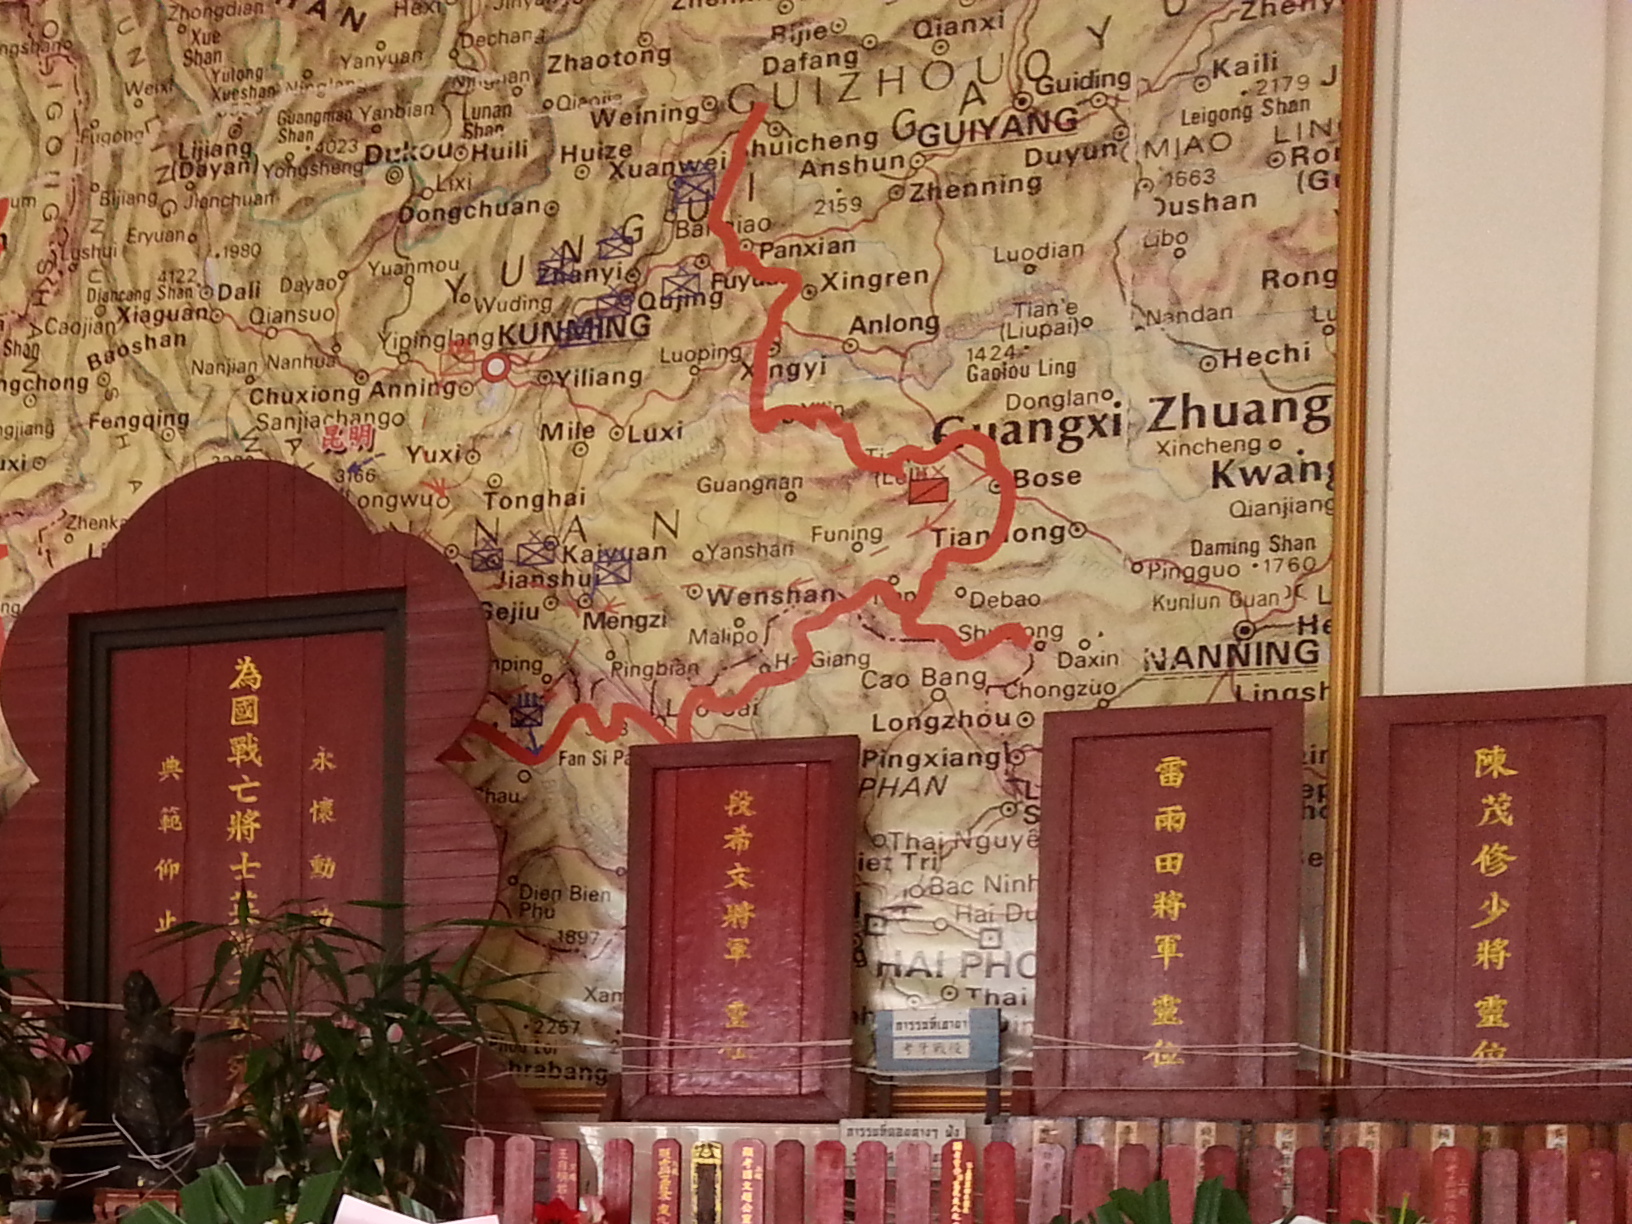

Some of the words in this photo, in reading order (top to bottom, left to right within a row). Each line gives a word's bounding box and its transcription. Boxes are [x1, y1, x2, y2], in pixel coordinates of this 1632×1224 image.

[168, 3, 265, 22] Zhongdian
[913, 11, 1005, 40] Qianxi
[191, 29, 220, 45] Xue
[183, 50, 222, 68] Shan
[548, 48, 672, 75] Zhaotong
[763, 50, 860, 76] Dafang
[1212, 50, 1279, 79] Kaili
[1035, 72, 1132, 96] Guiding
[1256, 75, 1311, 96] 2179
[462, 102, 512, 120] Lunan
[590, 103, 700, 129] Weining
[1181, 105, 1253, 129] Leigong
[1261, 97, 1311, 117] Shan
[277, 128, 314, 143] Shan
[918, 108, 1078, 148] GUIYANG
[179, 143, 253, 161] Lijiang
[472, 140, 529, 161] Huili
[560, 142, 633, 164] Huize
[1025, 142, 1118, 169] Duyun
[171, 155, 259, 180] (Dayan)
[799, 154, 905, 180] Anshun
[437, 176, 472, 193] Lixi
[910, 176, 1042, 202] Zhenning
[399, 200, 541, 225] Dongchuan
[815, 197, 863, 217] 2159
[127, 227, 186, 246] Eryuan
[224, 244, 262, 258] 1980
[760, 239, 856, 260] Panxian
[993, 243, 1085, 265] Luodian
[369, 258, 460, 276] Yuanmou
[158, 270, 197, 286] 4122
[280, 277, 337, 296] Dayao
[820, 270, 930, 293] Xingren
[158, 286, 193, 300] Shan
[219, 282, 261, 301] Dali
[637, 288, 724, 312] Qujing
[475, 295, 553, 314] Wuding
[119, 305, 212, 327] Xiaguan
[250, 307, 334, 329] Qiansuo
[44, 318, 116, 339] Caojian
[498, 314, 651, 346] KUNMING
[850, 316, 941, 337] Anlong
[378, 329, 495, 351] Yipinglang
[87, 333, 187, 371] Baoshan
[660, 346, 742, 364] Luoping
[967, 345, 1016, 362] 1424
[1222, 342, 1312, 368] Hechi
[191, 359, 258, 378] Nanjian
[558, 369, 643, 390] Yiliang
[249, 387, 361, 406] Chuxiong
[370, 382, 457, 400] Anning
[1006, 391, 1098, 412] Donglan
[88, 411, 190, 432] Fengqing
[1147, 392, 1333, 435] Zhuang
[539, 423, 596, 442] Mile
[627, 423, 684, 444] Luxi
[407, 446, 462, 465] Yuxi
[1157, 438, 1262, 457] Xincheng
[696, 476, 803, 496] Guangnan
[1013, 469, 1082, 489] Bose
[484, 489, 586, 513] Tonghai
[811, 526, 884, 546] Funing
[1190, 538, 1260, 558] Daming
[1268, 534, 1316, 552] Shan
[706, 541, 795, 561] Yanshan
[1148, 562, 1240, 583] Pingguo
[1264, 556, 1317, 575] 1760
[707, 587, 837, 607] Wenshan
[970, 591, 1041, 610] Debao
[1230, 592, 1280, 608] Guan
[583, 612, 668, 632] Mengzi
[688, 629, 758, 647] Malipo
[811, 651, 871, 671] Giang
[1057, 653, 1120, 670] Daxin
[1143, 639, 1320, 672] NANNING
[611, 661, 700, 680] Pingbian
[862, 669, 909, 689] Cao
[921, 667, 988, 691] Bang
[872, 709, 1011, 734] Longzhou
[559, 751, 586, 767] Fan
[592, 751, 608, 767] Si
[861, 748, 1005, 772] Pingxiang
[569, 886, 611, 904] Bien
[929, 877, 975, 895] Bac
